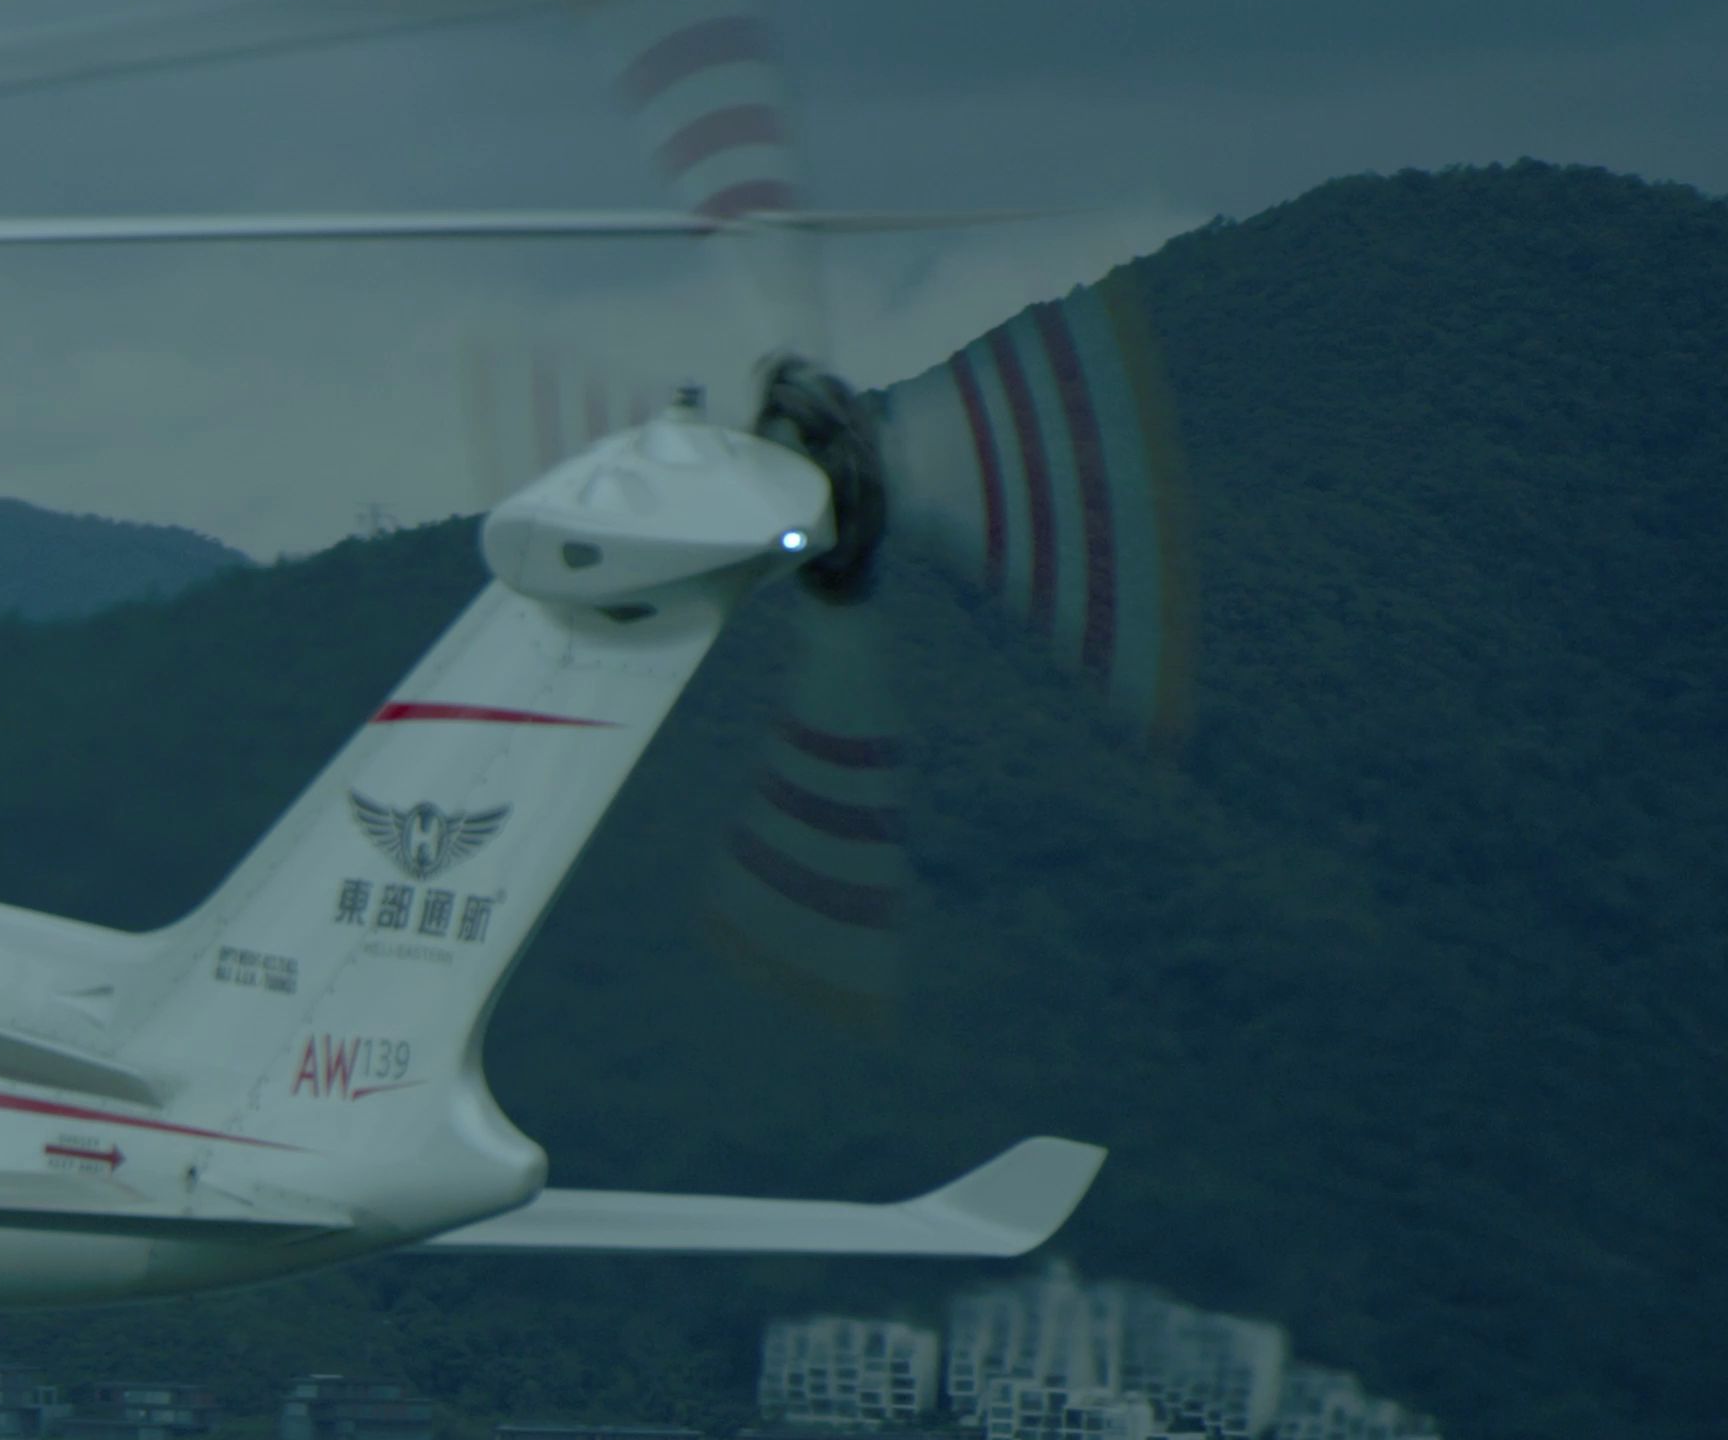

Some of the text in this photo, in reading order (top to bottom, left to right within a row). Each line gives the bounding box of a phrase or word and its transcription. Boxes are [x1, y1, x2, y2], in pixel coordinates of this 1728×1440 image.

[334, 877, 497, 944] 東部通航
[290, 1032, 412, 1100] AW139
